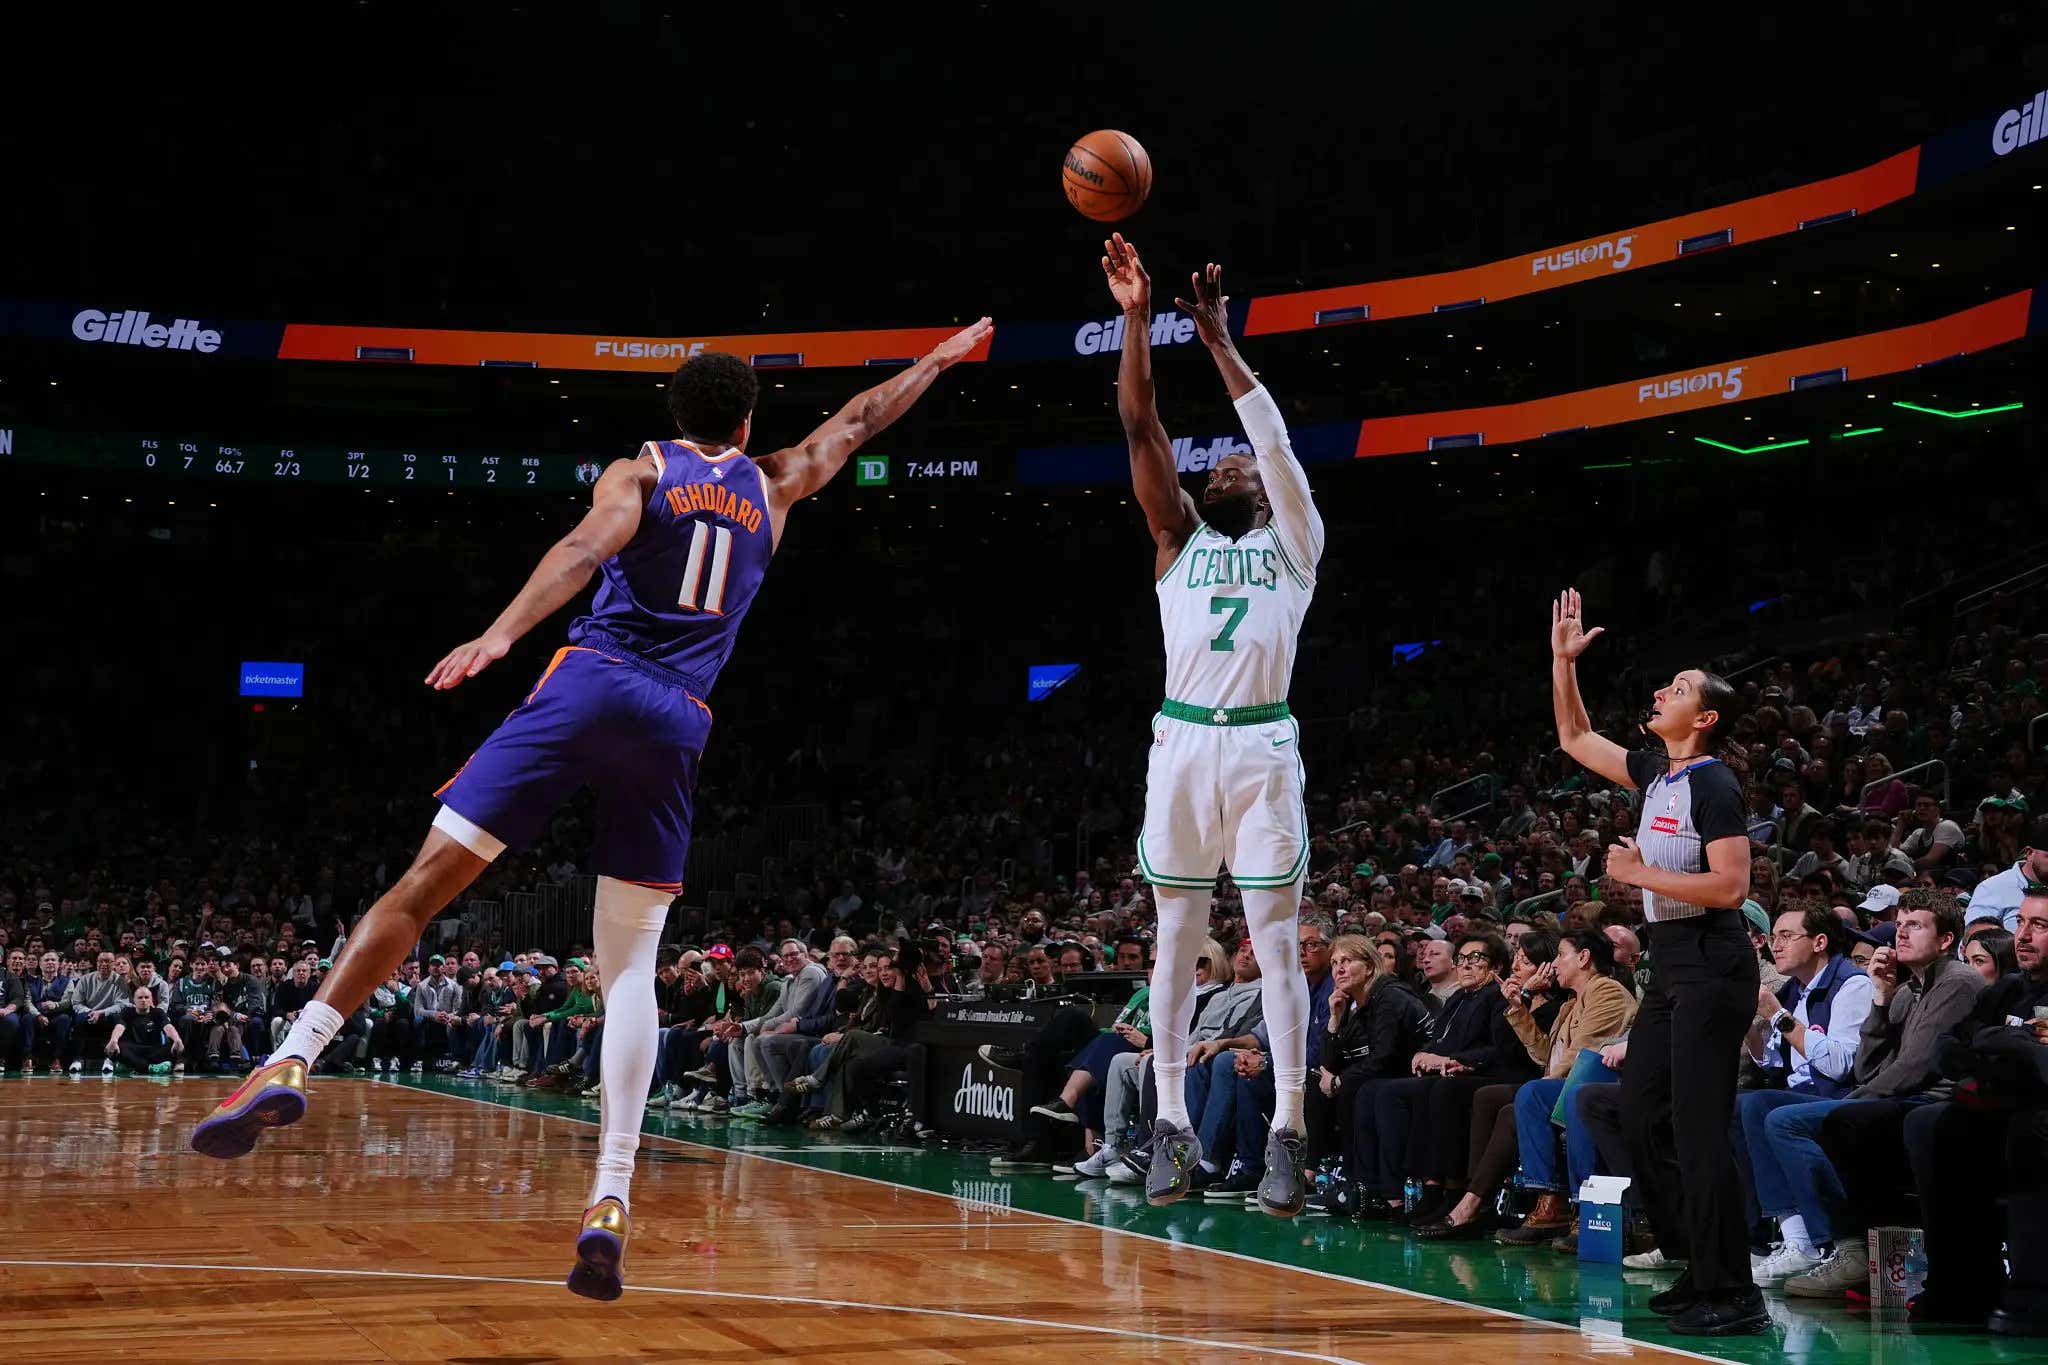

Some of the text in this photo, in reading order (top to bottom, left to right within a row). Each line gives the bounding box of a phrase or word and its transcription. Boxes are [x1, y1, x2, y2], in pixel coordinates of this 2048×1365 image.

[71, 309, 222, 353] Gillette
[1074, 312, 1195, 356] Giltte
[142, 440, 540, 467] FLS TOL FG% FG 3PT TO STL AST REB
[146, 454, 536, 484] 0 7 66.7 2/3 1/2 2 1 2 2
[860, 461, 886, 480] TD
[907, 461, 978, 478] 7:44 PM
[665, 483, 762, 533] IGHODARO
[678, 519, 733, 616] 11
[1187, 548, 1277, 591] CELTICS
[1210, 596, 1249, 651] 7
[245, 674, 298, 685] ticketmaster
[954, 1063, 1014, 1122] Amica
